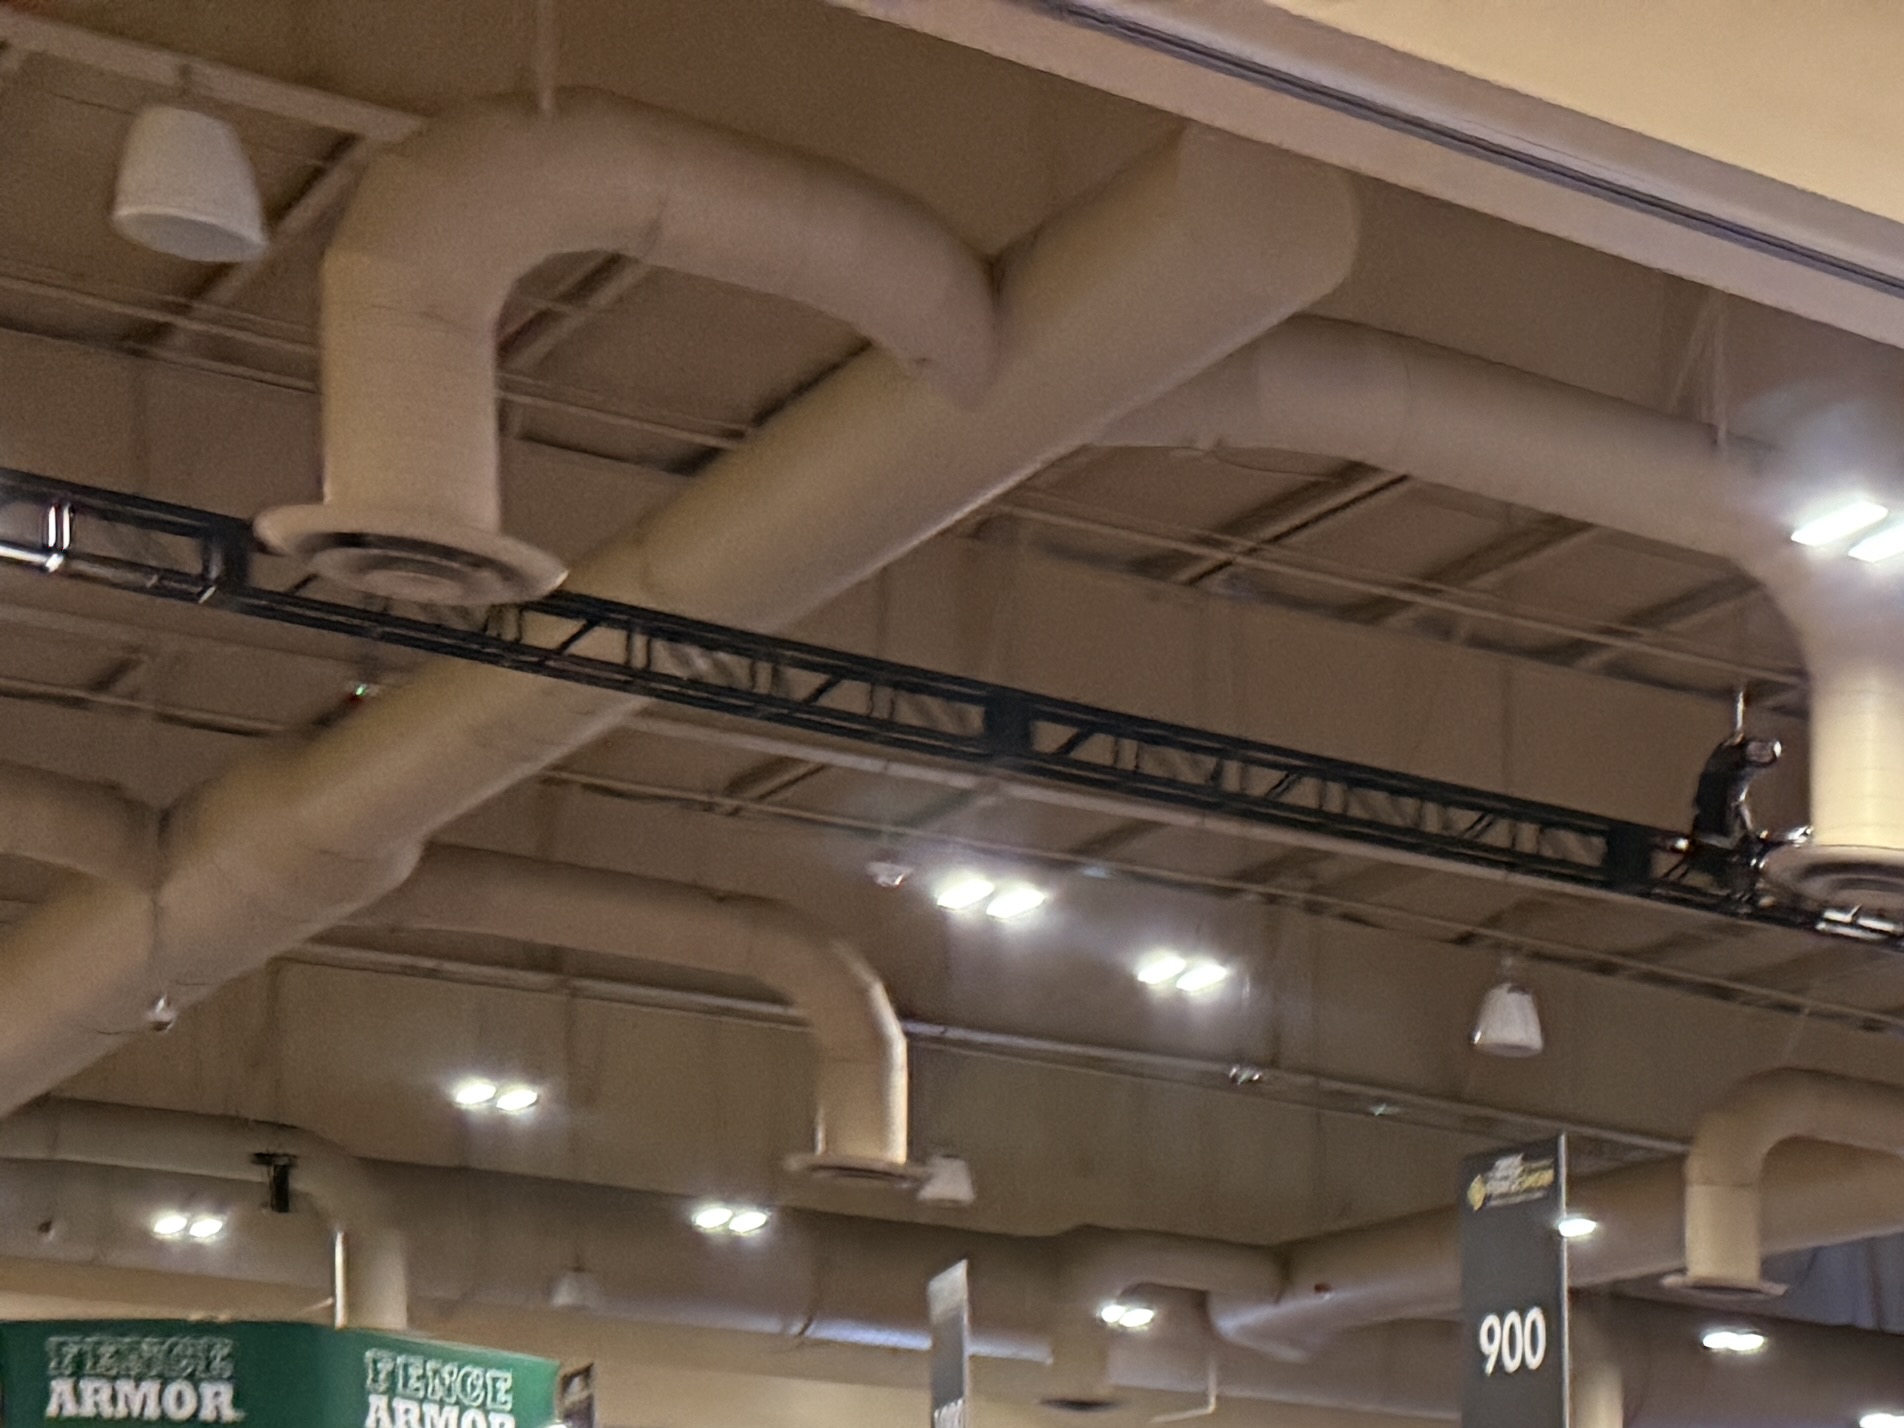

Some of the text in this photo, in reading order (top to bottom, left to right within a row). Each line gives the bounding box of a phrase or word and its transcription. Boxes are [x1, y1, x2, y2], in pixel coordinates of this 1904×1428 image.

[1479, 1306, 1547, 1377] 900
[44, 1376, 236, 1424] ARMOR
[363, 1347, 514, 1411] FENCE
